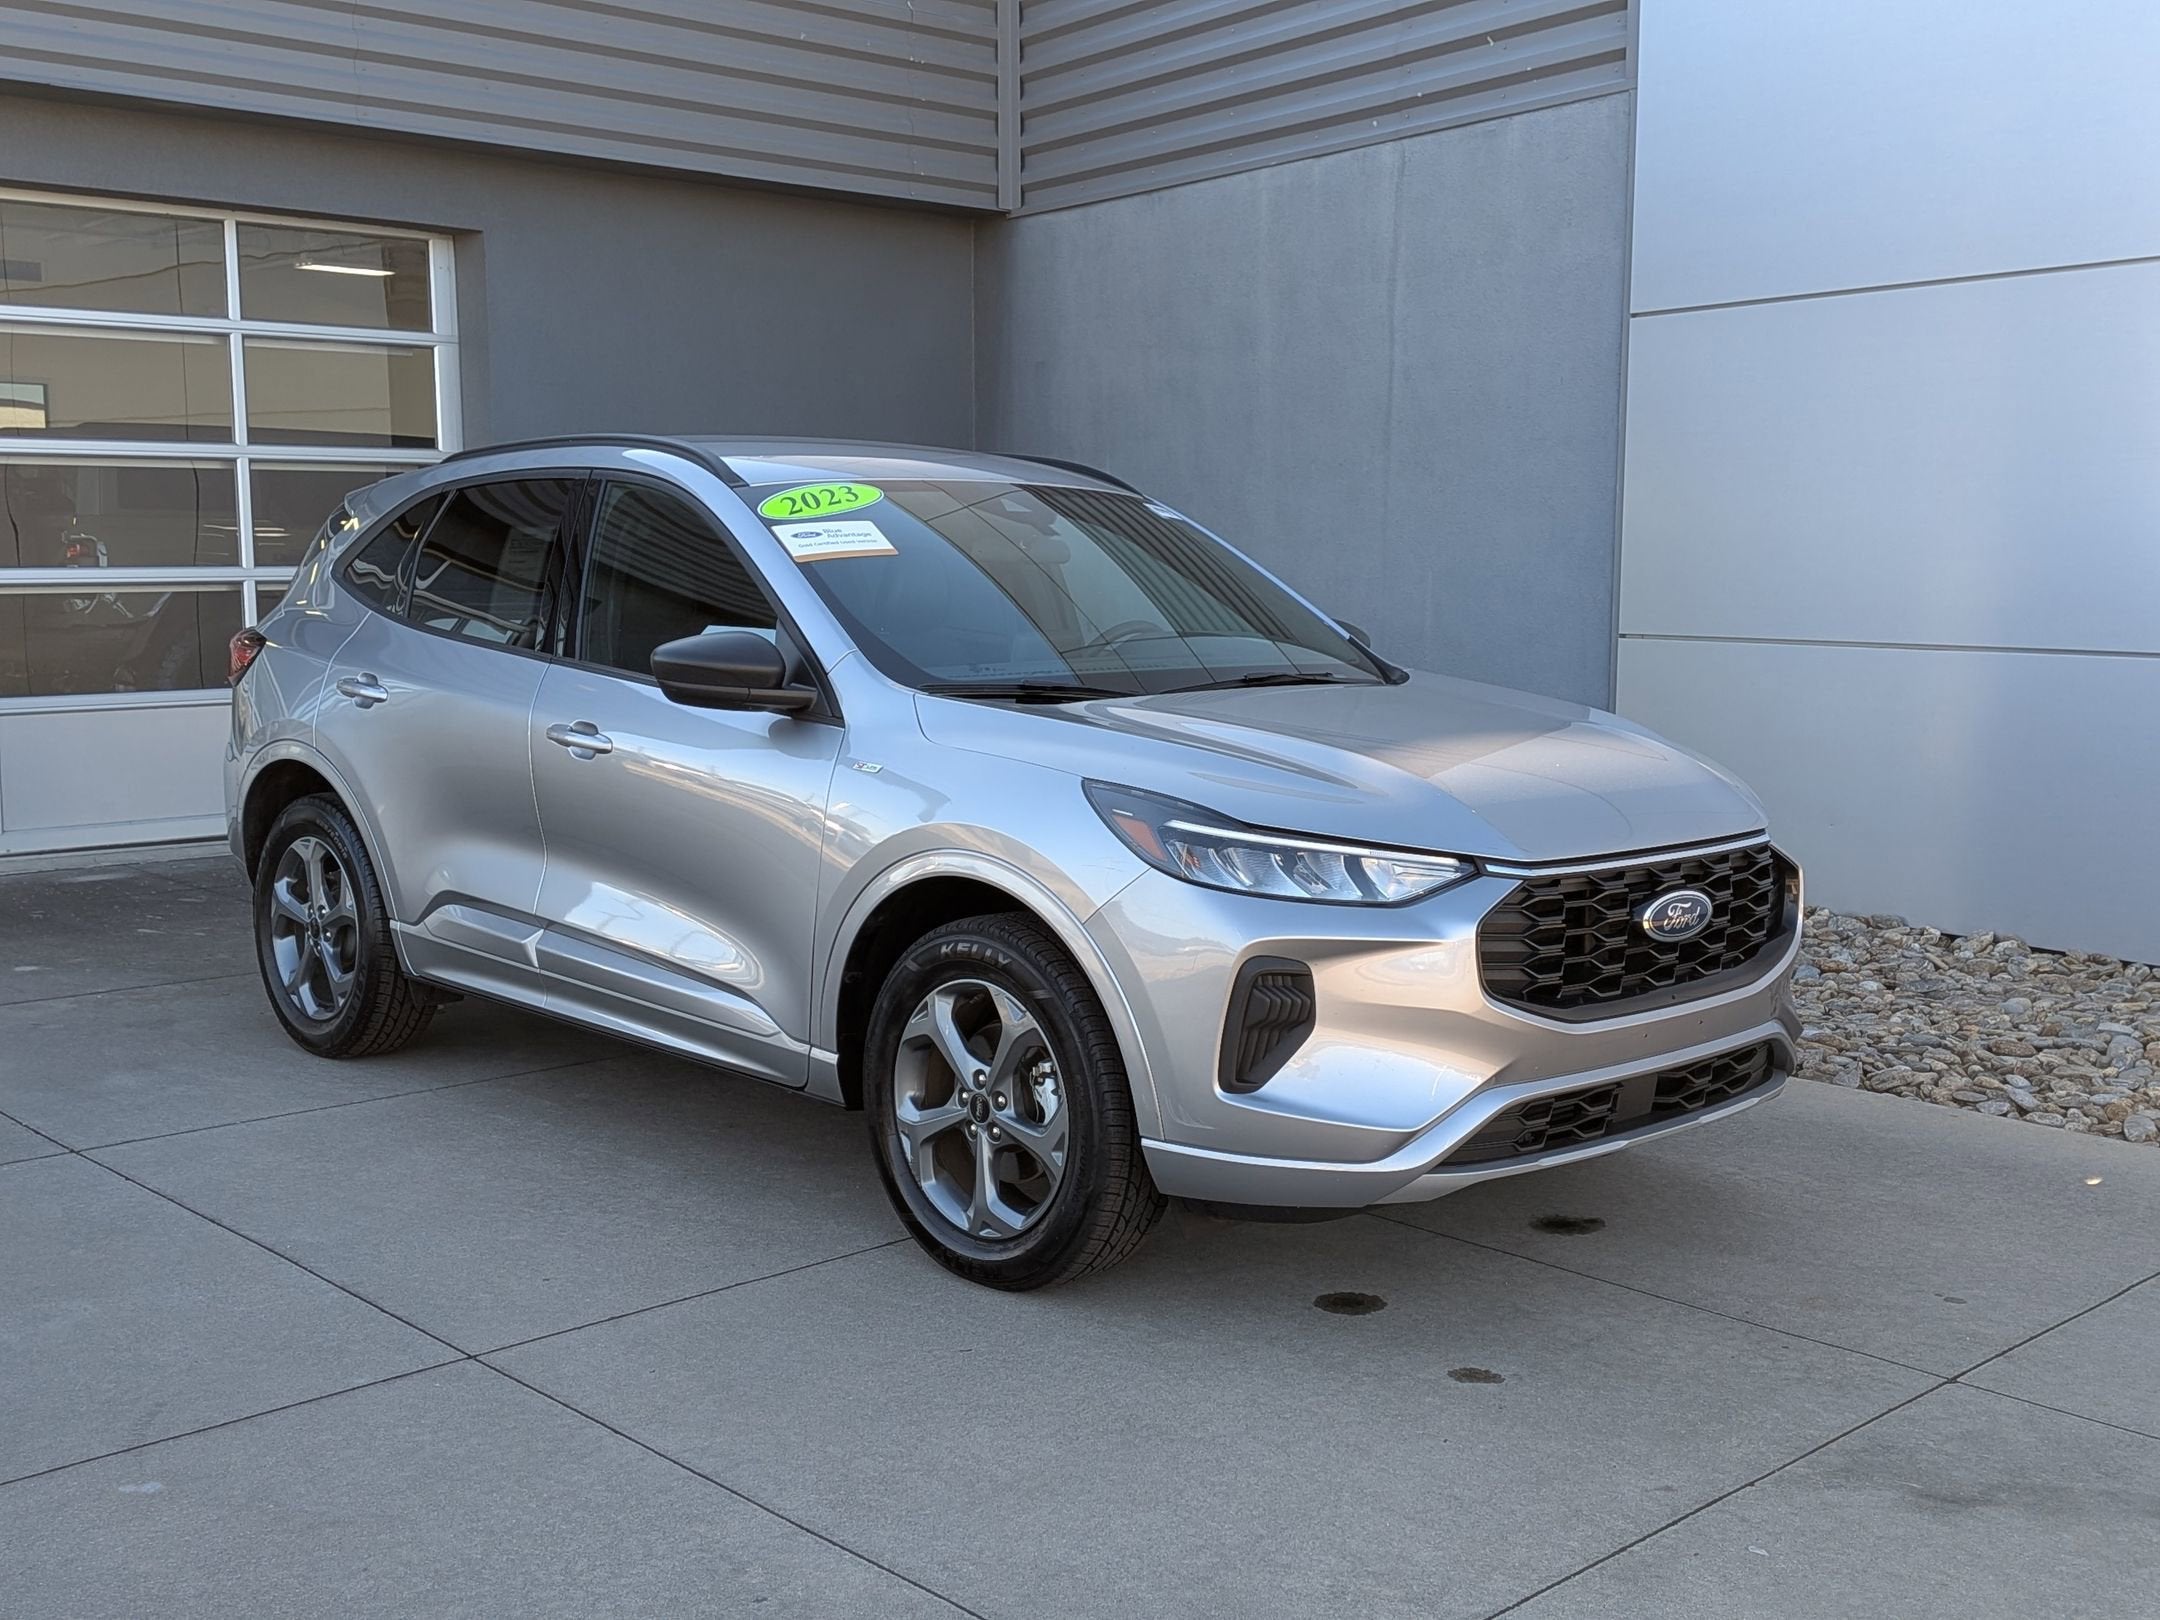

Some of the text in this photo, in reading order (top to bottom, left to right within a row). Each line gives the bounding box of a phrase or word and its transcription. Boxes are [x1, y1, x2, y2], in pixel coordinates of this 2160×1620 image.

[780, 486, 859, 516] 2023
[1663, 902, 1701, 931] Ford
[939, 942, 1012, 966] KELLY
